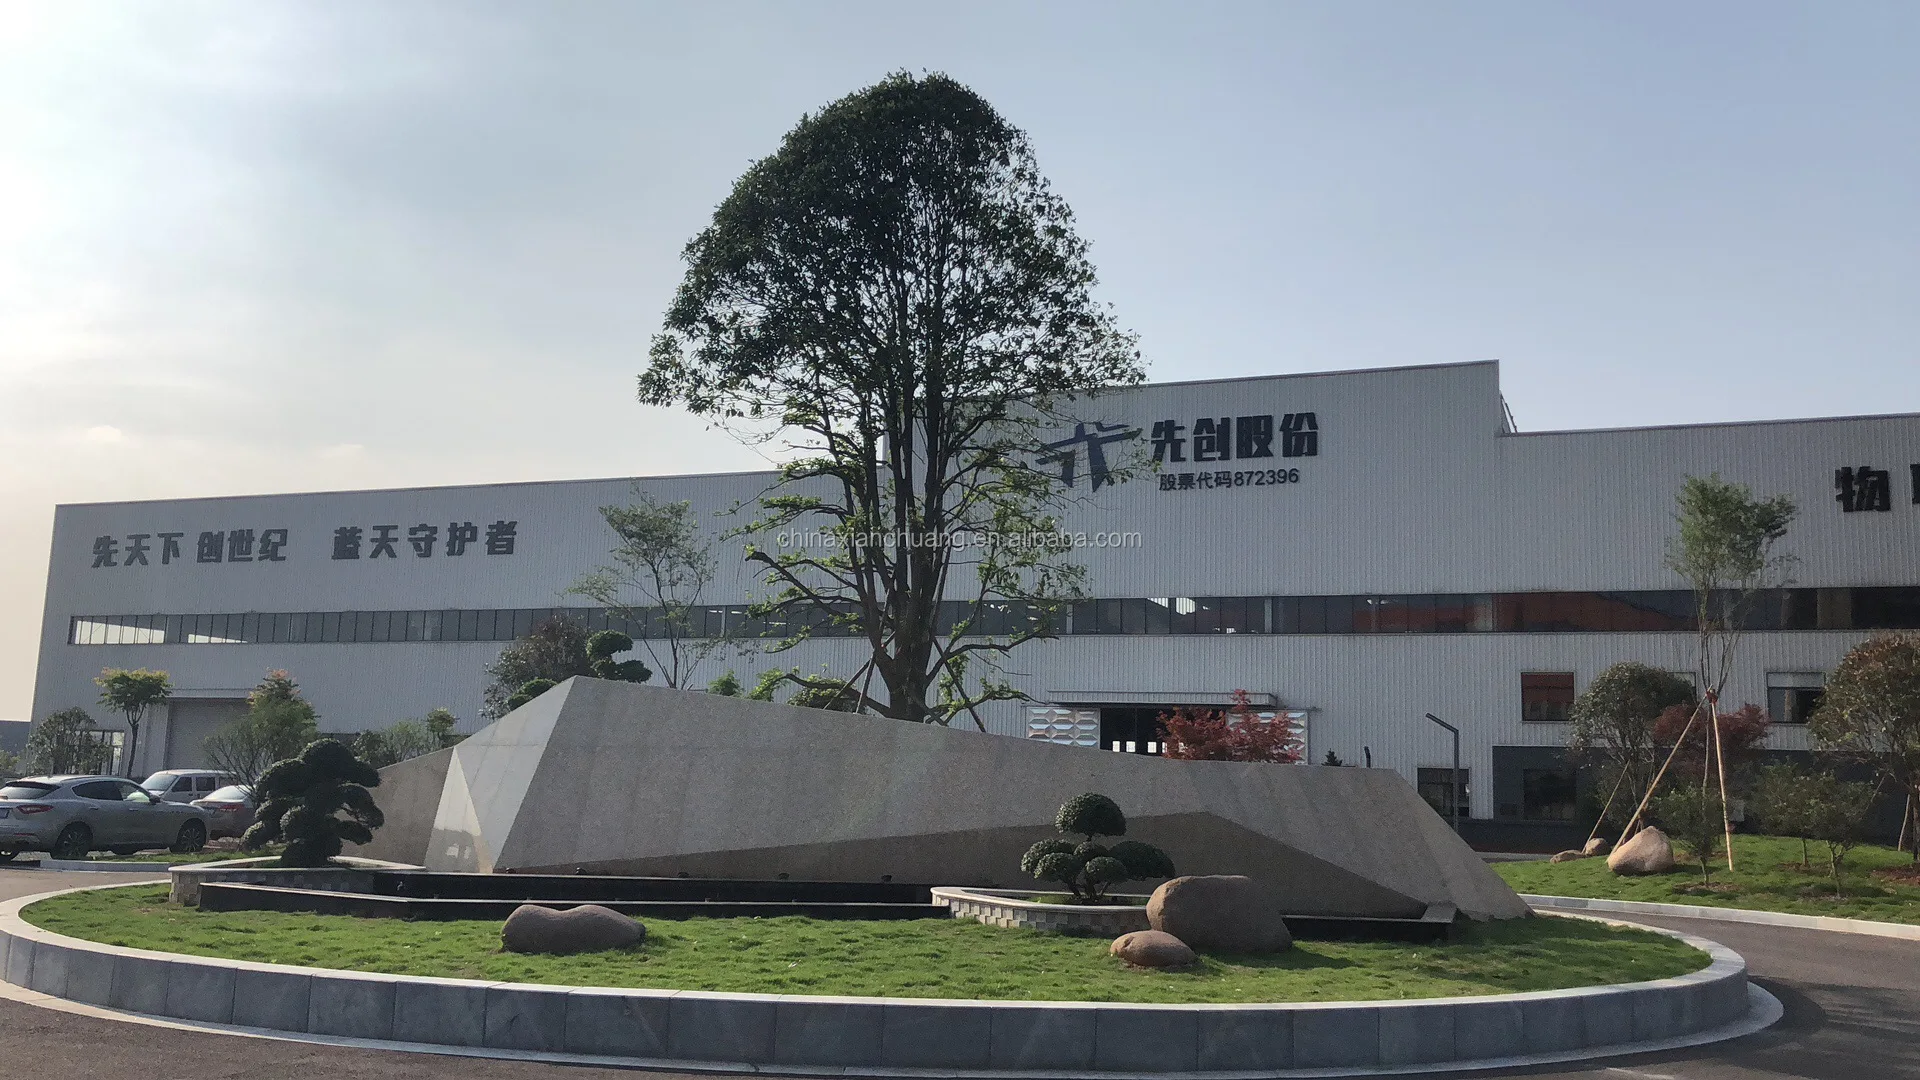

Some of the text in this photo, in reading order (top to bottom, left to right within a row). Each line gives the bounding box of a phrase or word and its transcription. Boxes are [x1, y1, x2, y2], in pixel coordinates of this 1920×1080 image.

[1151, 412, 1319, 462] 先创股份
[1159, 468, 1299, 491] 股票代码872396
[1834, 464, 1920, 512] 物
[332, 520, 518, 560] 蓝天守护者
